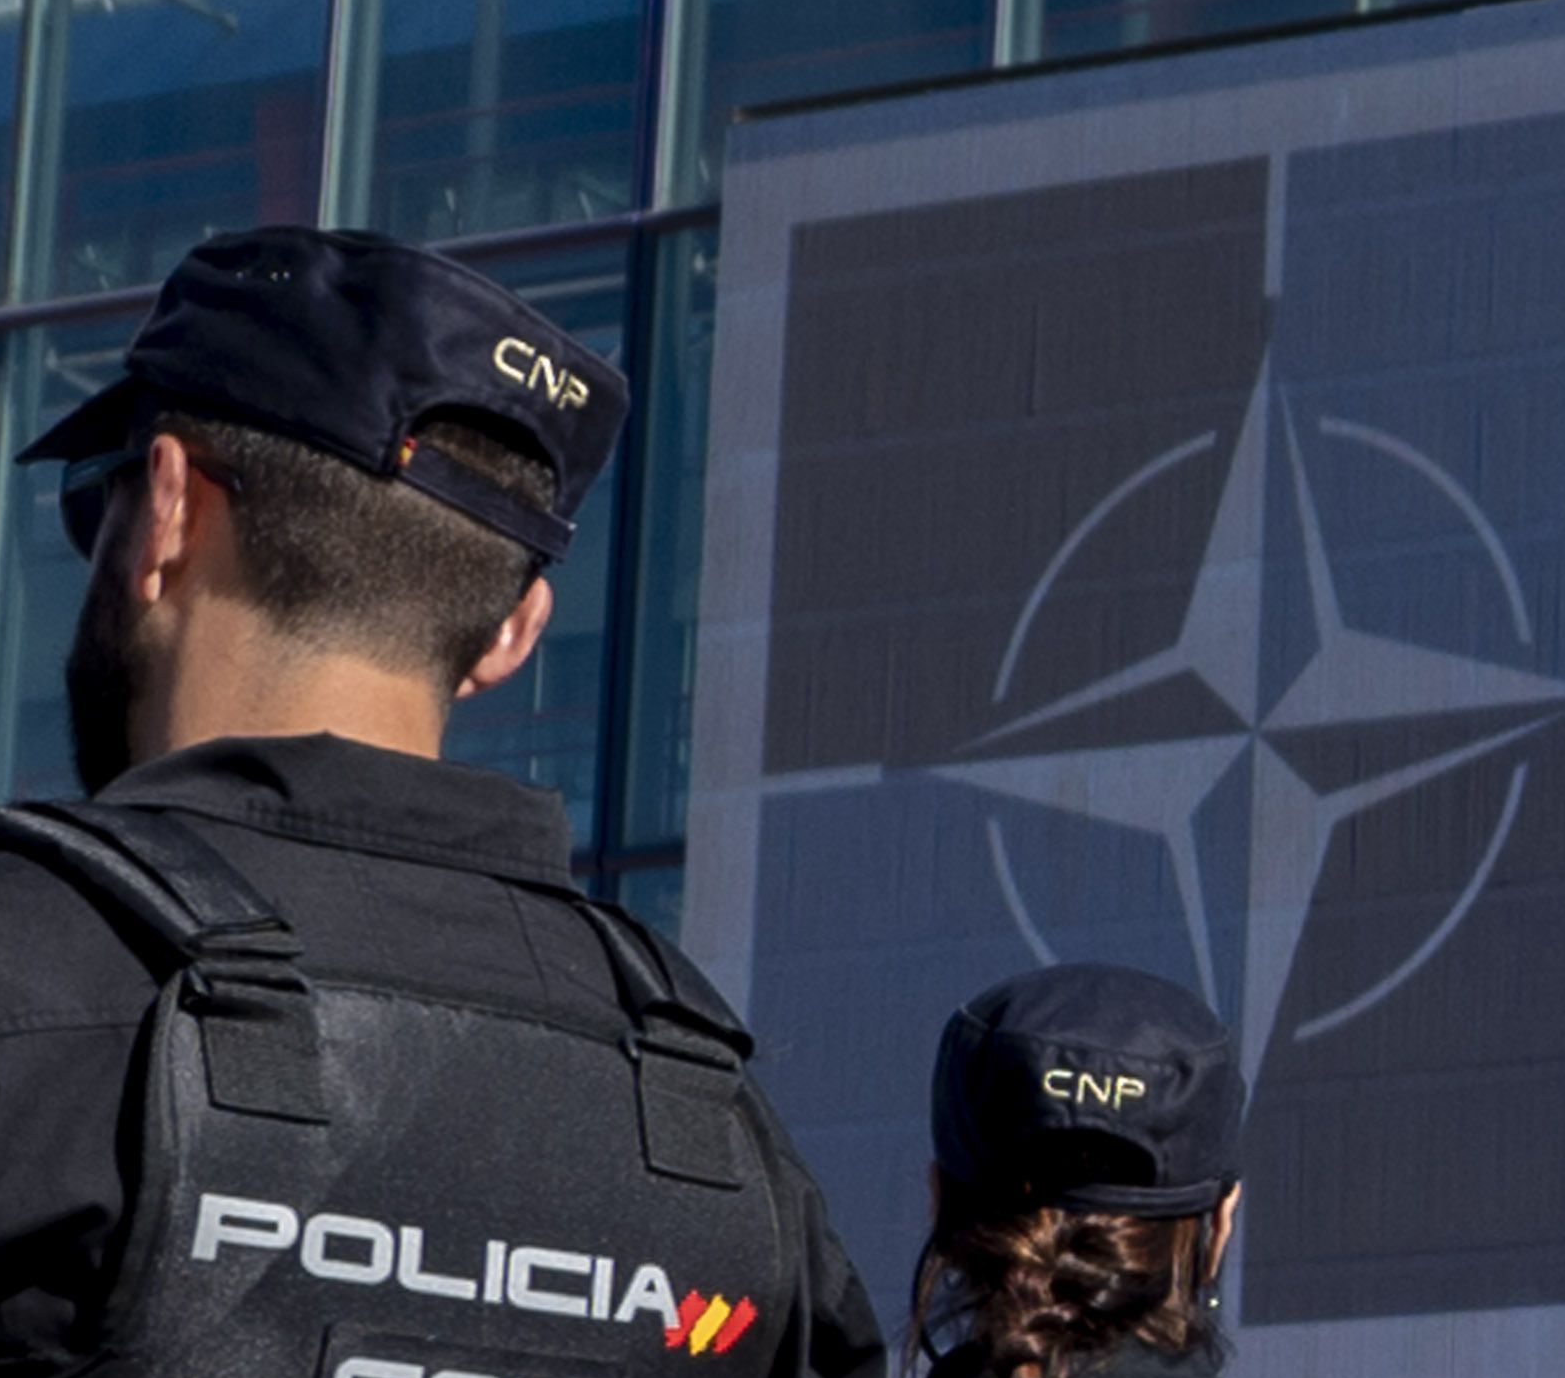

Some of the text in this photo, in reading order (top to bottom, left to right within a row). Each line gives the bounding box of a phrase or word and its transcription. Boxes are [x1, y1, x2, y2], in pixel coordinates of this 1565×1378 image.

[492, 336, 590, 412] CNP
[1041, 1069, 1146, 1110] CNP
[191, 1193, 682, 1330] POLICIA
